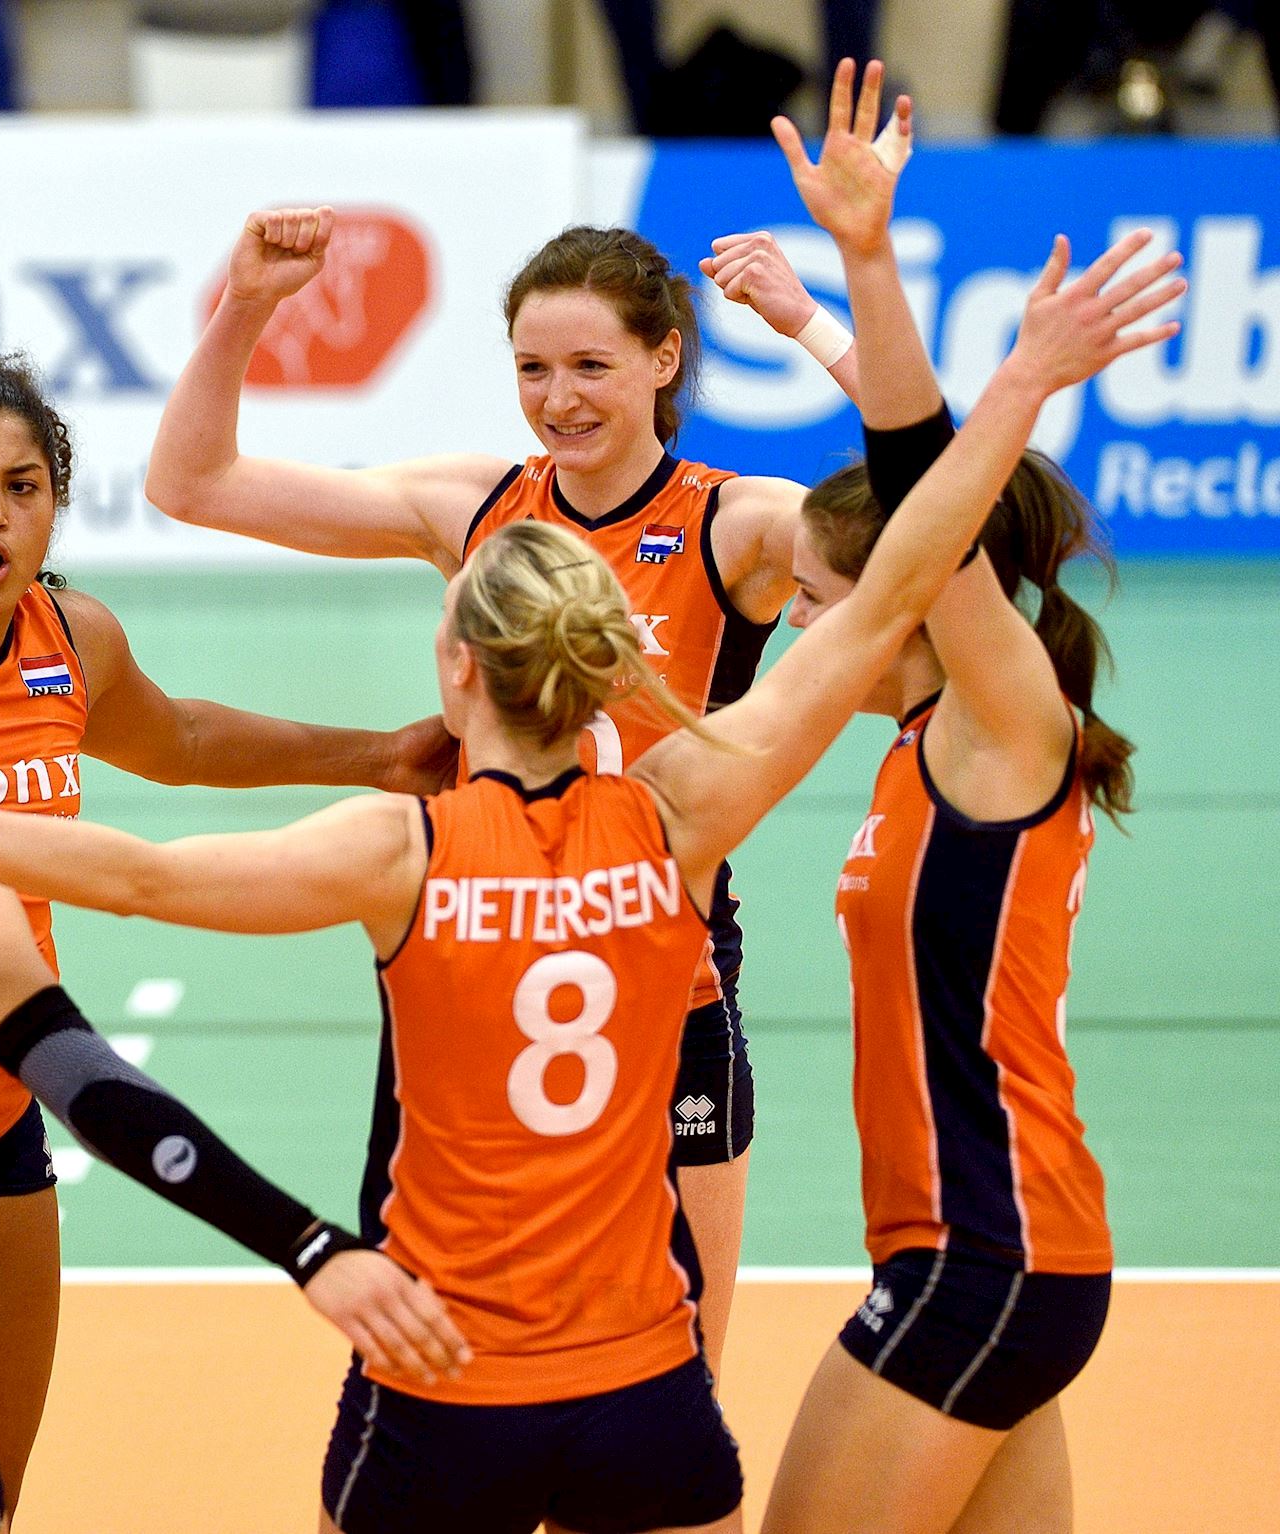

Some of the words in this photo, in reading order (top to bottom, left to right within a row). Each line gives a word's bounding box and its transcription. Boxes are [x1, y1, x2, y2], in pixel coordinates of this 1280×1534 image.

[31, 685, 71, 696] NED
[424, 858, 680, 941] PIETERSEN
[507, 950, 617, 1137] 8
[674, 1119, 716, 1136] errea
